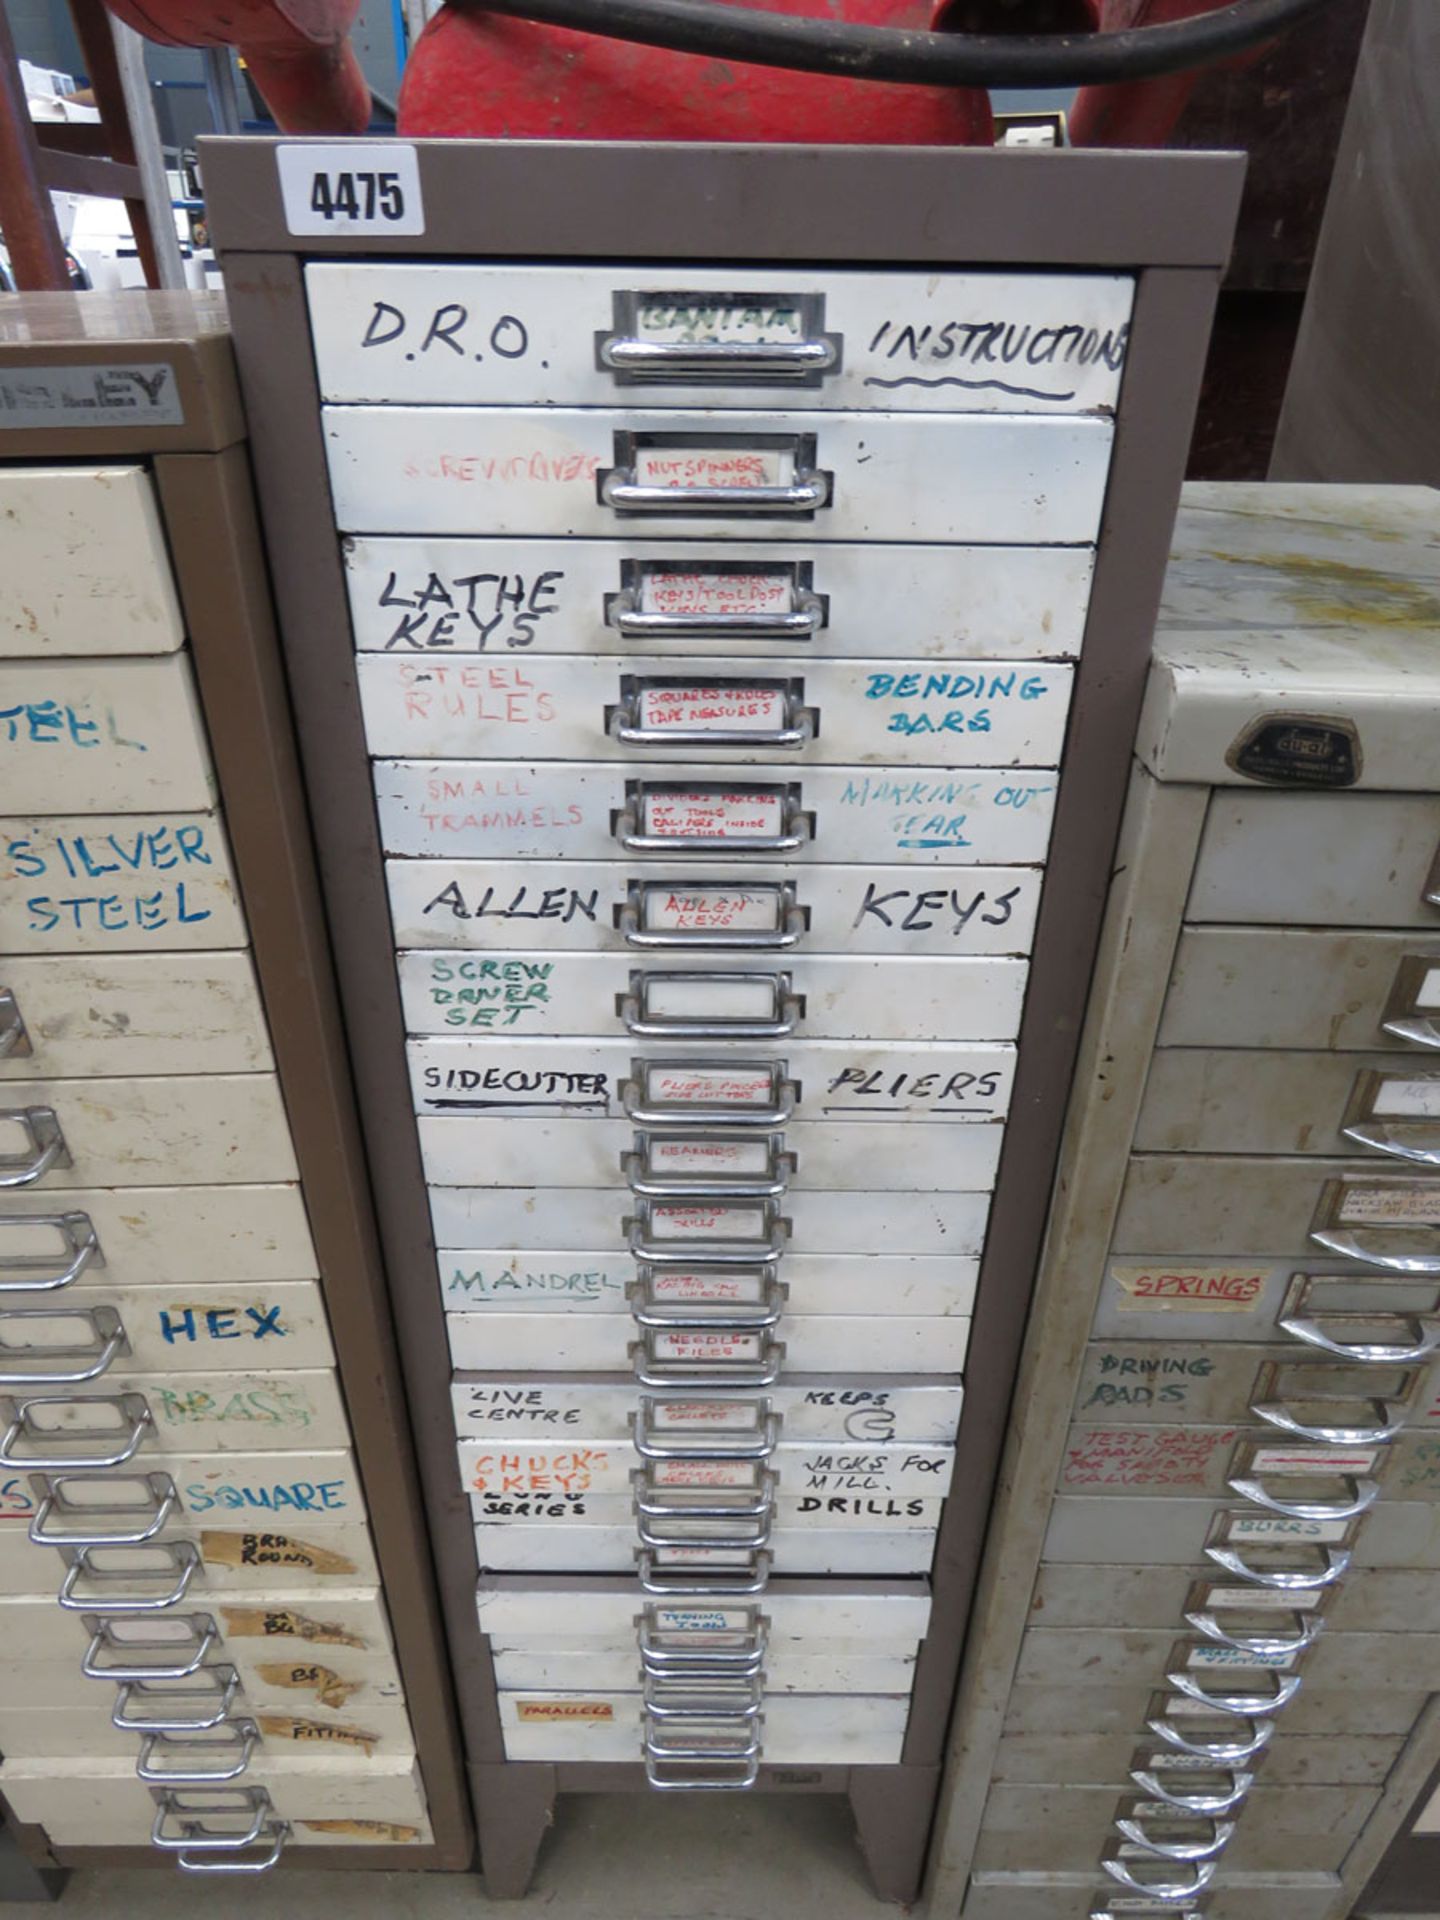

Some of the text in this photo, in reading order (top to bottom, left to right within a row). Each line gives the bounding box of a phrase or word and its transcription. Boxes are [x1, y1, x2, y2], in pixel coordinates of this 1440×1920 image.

[310, 172, 405, 221] 4475
[361, 302, 550, 368] D.R.O.
[378, 569, 565, 614] LATHE
[384, 609, 541, 651] KEYS
[399, 663, 534, 689] STEEL
[865, 671, 1048, 700] BENDING
[403, 691, 556, 723] RULES
[887, 708, 992, 736] BARS
[426, 779, 530, 801] SMALL
[993, 785, 1053, 809] OUT
[7, 824, 213, 878] SILVER
[26, 881, 212, 931] STEEL
[423, 880, 599, 923] ALLEN
[664, 892, 747, 913] ALLEN
[852, 882, 1021, 936] KEYS
[676, 914, 733, 928] KEYS
[430, 957, 555, 982] SCREW
[827, 1067, 1003, 1100] PLIERS
[448, 1269, 622, 1293] MANDREL
[1133, 1275, 1262, 1296] SPRINGS
[159, 1305, 289, 1344] HEX
[470, 1390, 543, 1405] LIVE
[467, 1408, 581, 1424] CENTRE
[1084, 1431, 1150, 1446] TEST
[503, 1473, 592, 1492] KEYS
[186, 1480, 346, 1512] SQUARE
[796, 1496, 924, 1517] DRILLS
[483, 1502, 586, 1517] SERIES
[1236, 1519, 1323, 1536] BURRS
